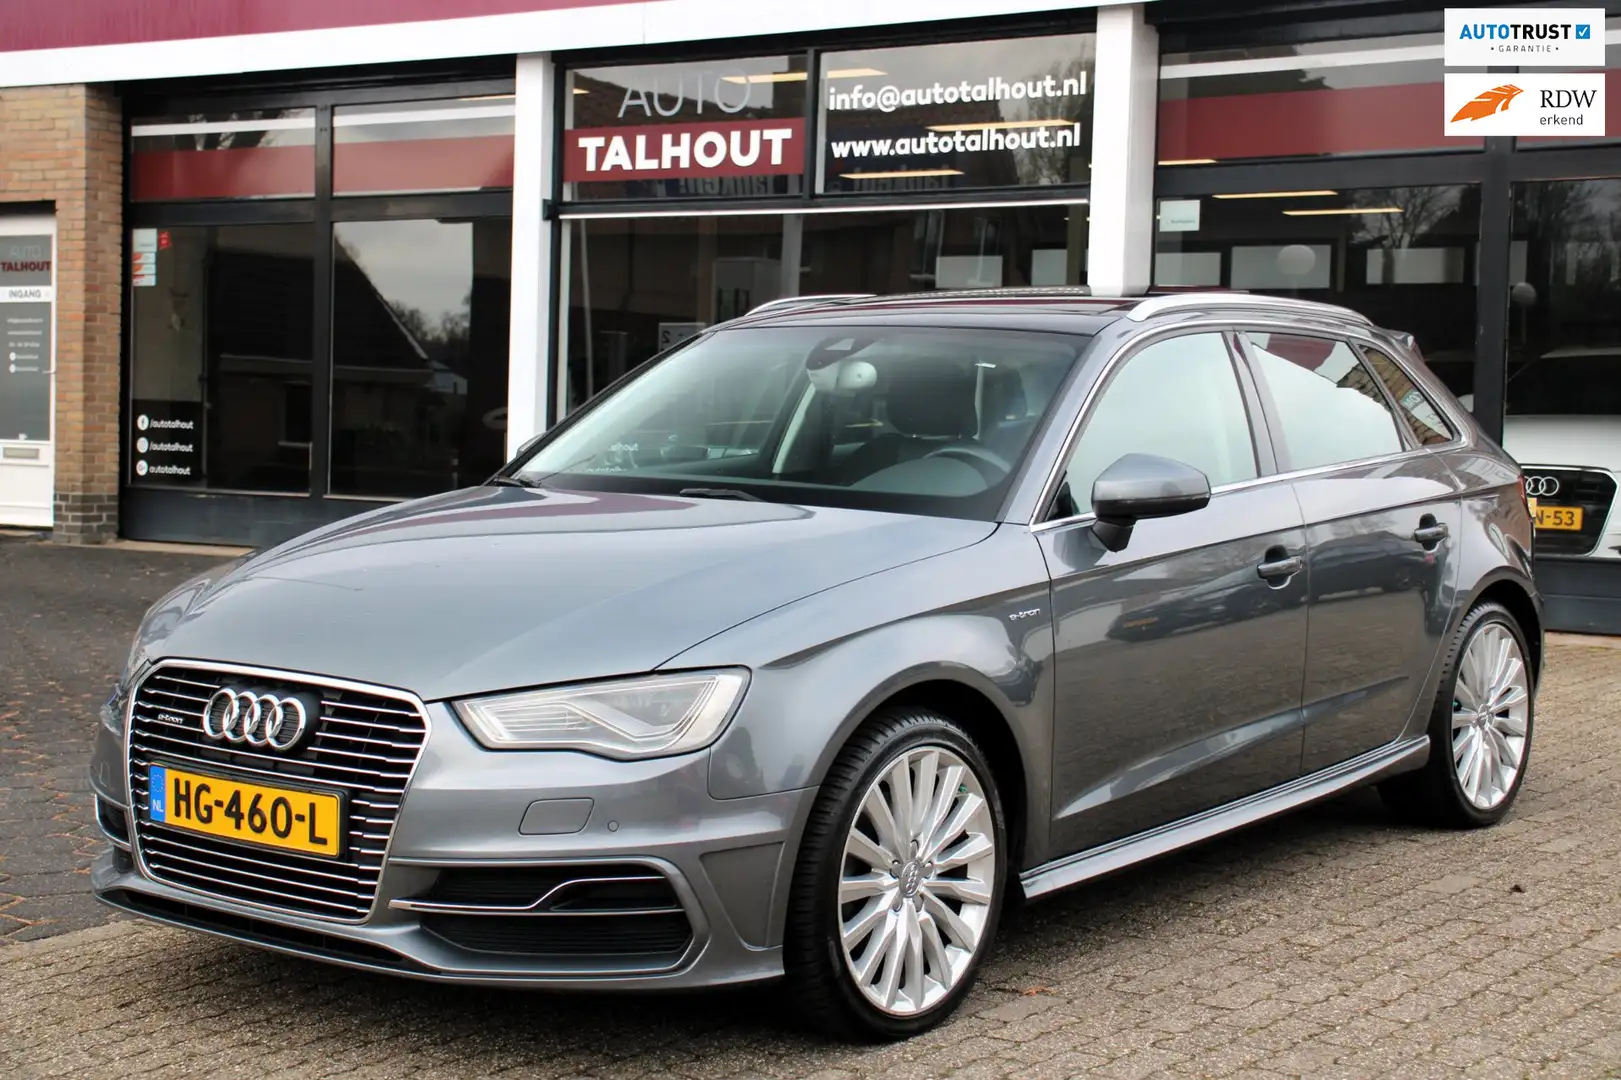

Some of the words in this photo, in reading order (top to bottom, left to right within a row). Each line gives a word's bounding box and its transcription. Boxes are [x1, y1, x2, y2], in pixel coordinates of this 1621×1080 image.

[617, 68, 750, 118] AUTO
[828, 71, 1087, 113] info@autotalhout.nl
[578, 128, 793, 172] TALHOUT
[831, 122, 1081, 158] www.autotalhout.nl
[1, 261, 51, 272] TALHOUT
[152, 799, 164, 812] NL
[174, 778, 328, 845] HG-460-L
